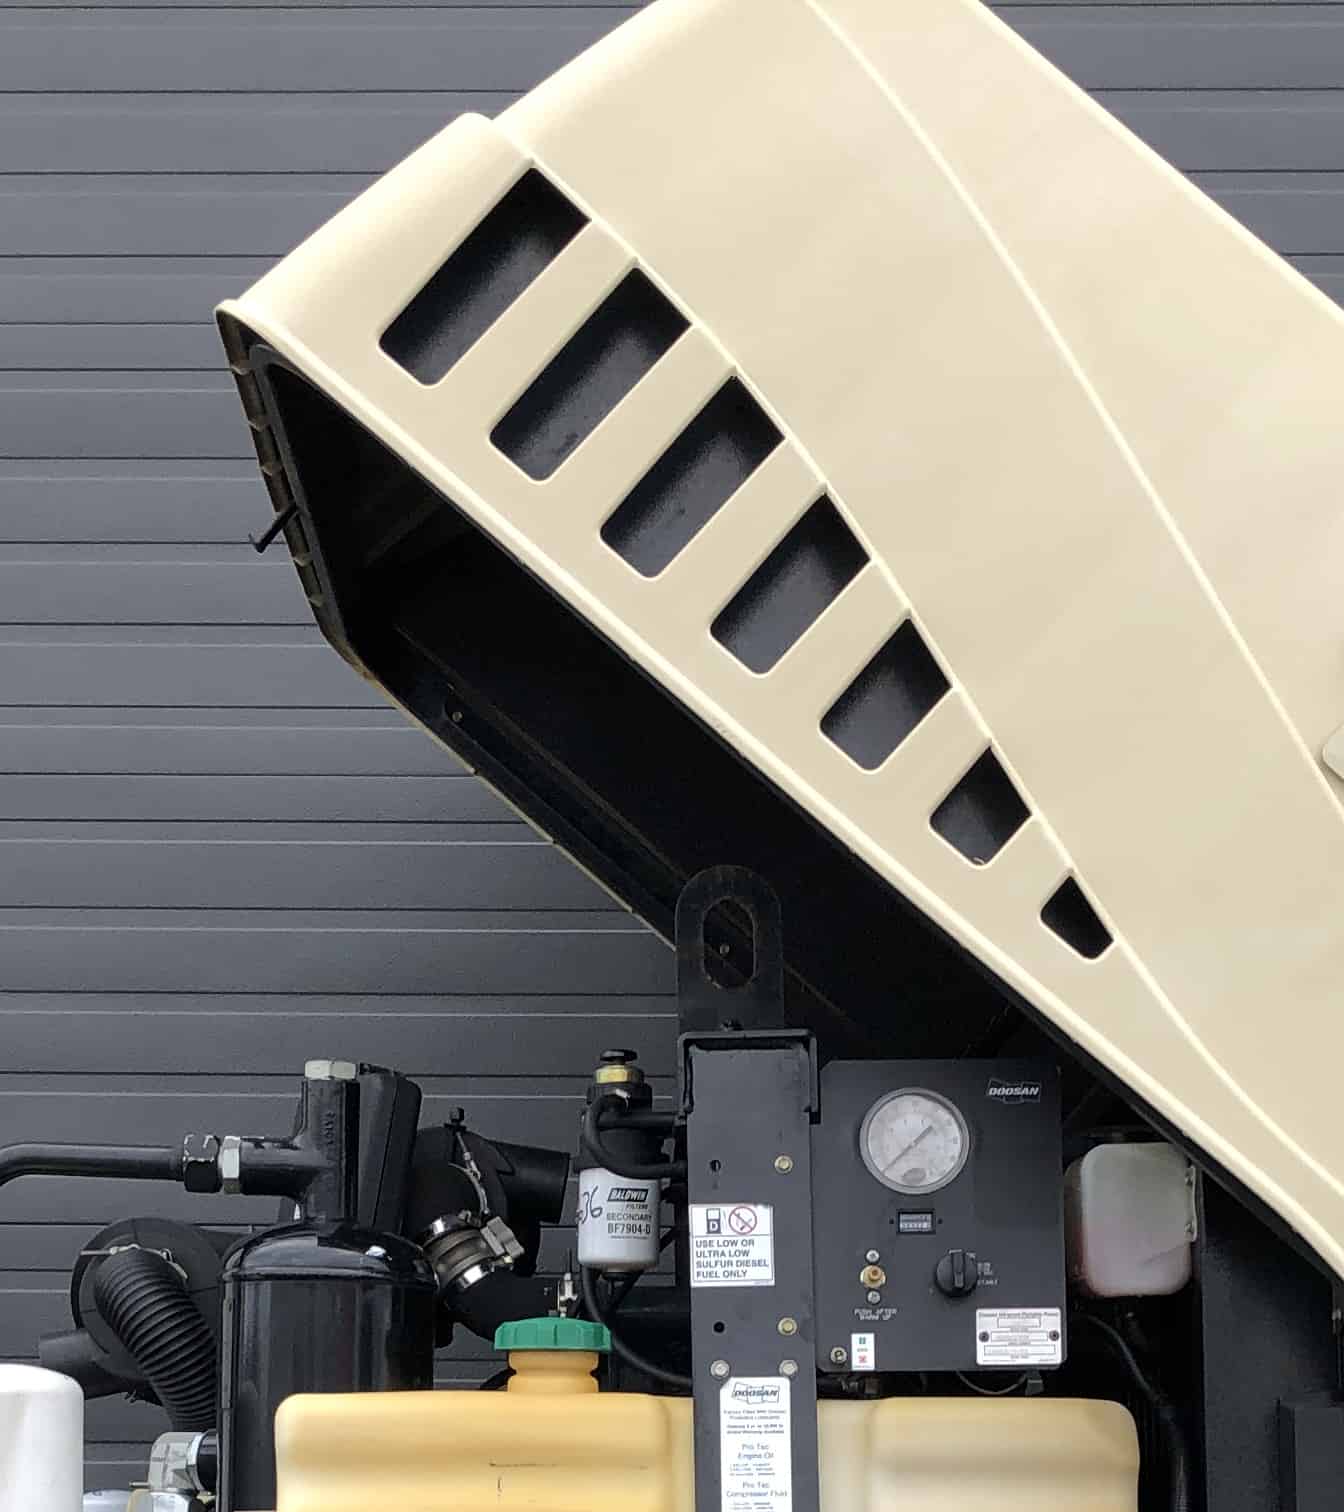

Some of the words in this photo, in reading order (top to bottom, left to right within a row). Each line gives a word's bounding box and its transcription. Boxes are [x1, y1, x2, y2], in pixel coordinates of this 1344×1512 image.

[988, 1087, 1039, 1096] DOOSAN
[609, 1188, 648, 1201] BALDWIN
[606, 1212, 652, 1221] SECONDARY
[695, 1239, 715, 1249] USE
[717, 1239, 738, 1248] LOW
[741, 1238, 755, 1247] OR
[695, 1249, 727, 1258] ULTRA
[728, 1248, 750, 1258] LOW
[695, 1259, 734, 1269] SULFUR
[735, 1258, 769, 1268] DIESEL
[696, 1270, 721, 1279] FUEL
[722, 1269, 748, 1278] ONLY
[733, 1389, 778, 1397] DOOSAN
